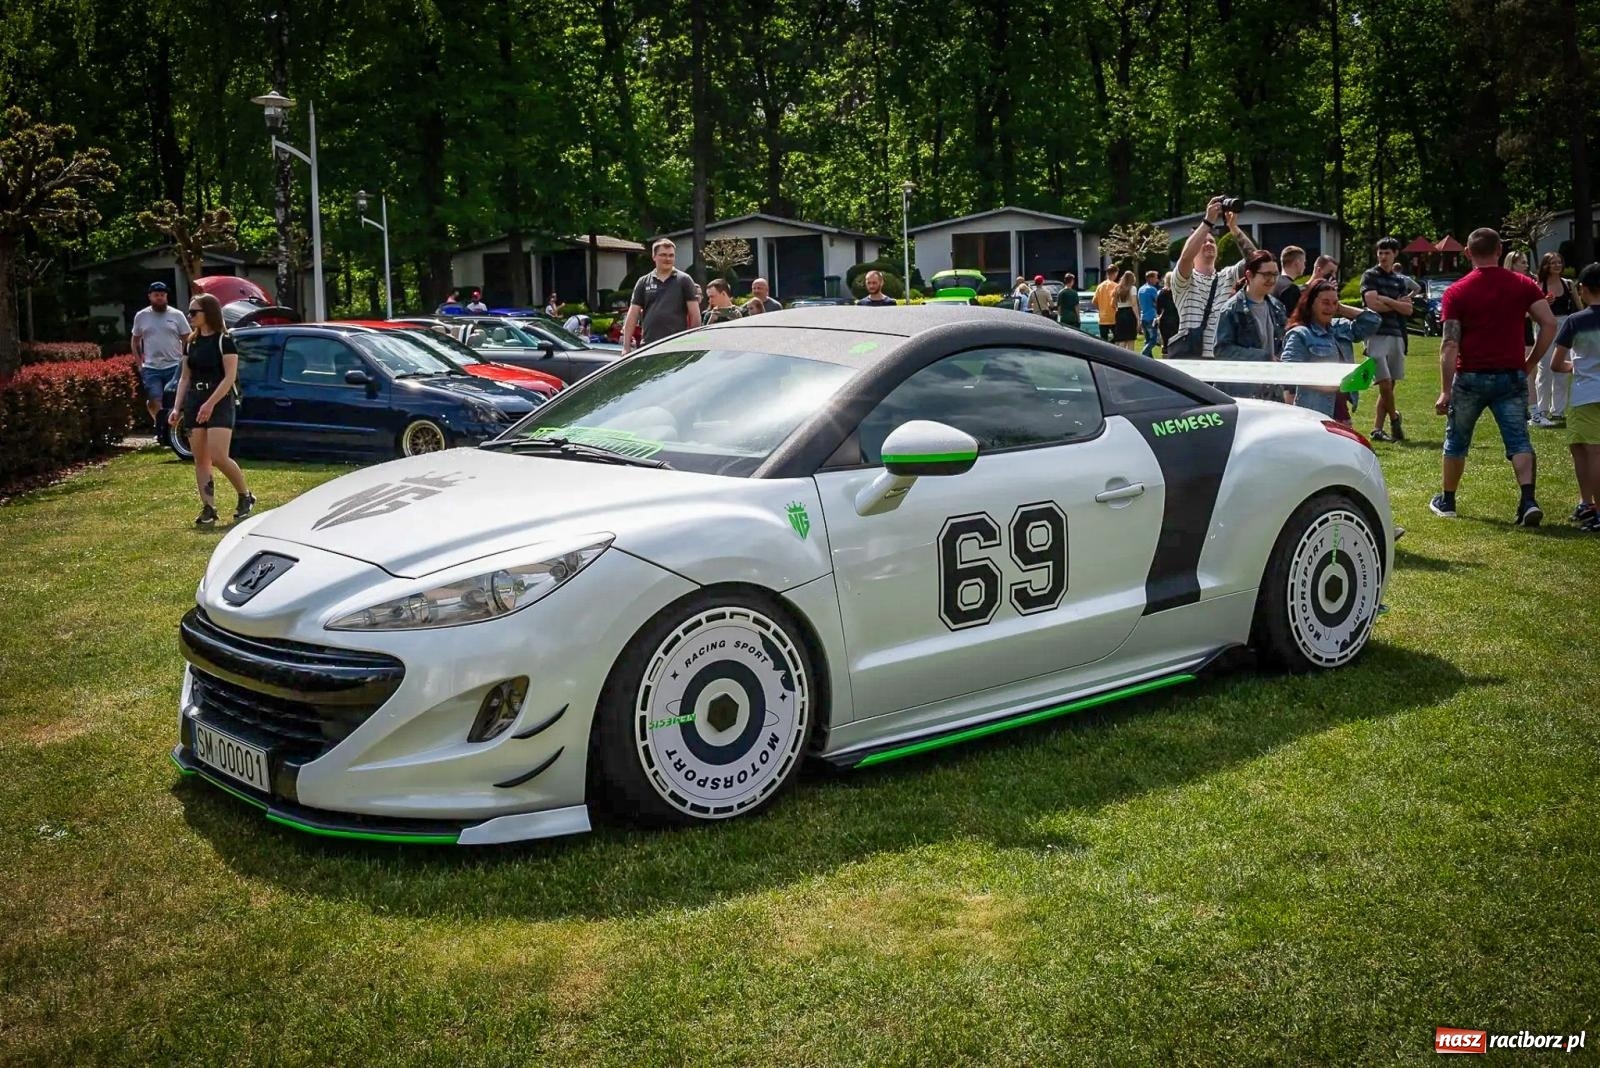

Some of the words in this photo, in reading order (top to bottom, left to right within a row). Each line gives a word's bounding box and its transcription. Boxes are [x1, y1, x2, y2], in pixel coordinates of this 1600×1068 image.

[1151, 412, 1225, 437] NEMESIS
[937, 500, 1069, 632] 69
[1299, 536, 1325, 642] MOTORSPORT
[1356, 551, 1369, 588] RACING
[1352, 595, 1367, 627] SPORT
[684, 639, 727, 668] RACING
[733, 640, 770, 664] SPORT
[197, 726, 214, 763] SM
[218, 738, 264, 786] 00001
[664, 732, 781, 791] MOTORSPORT
